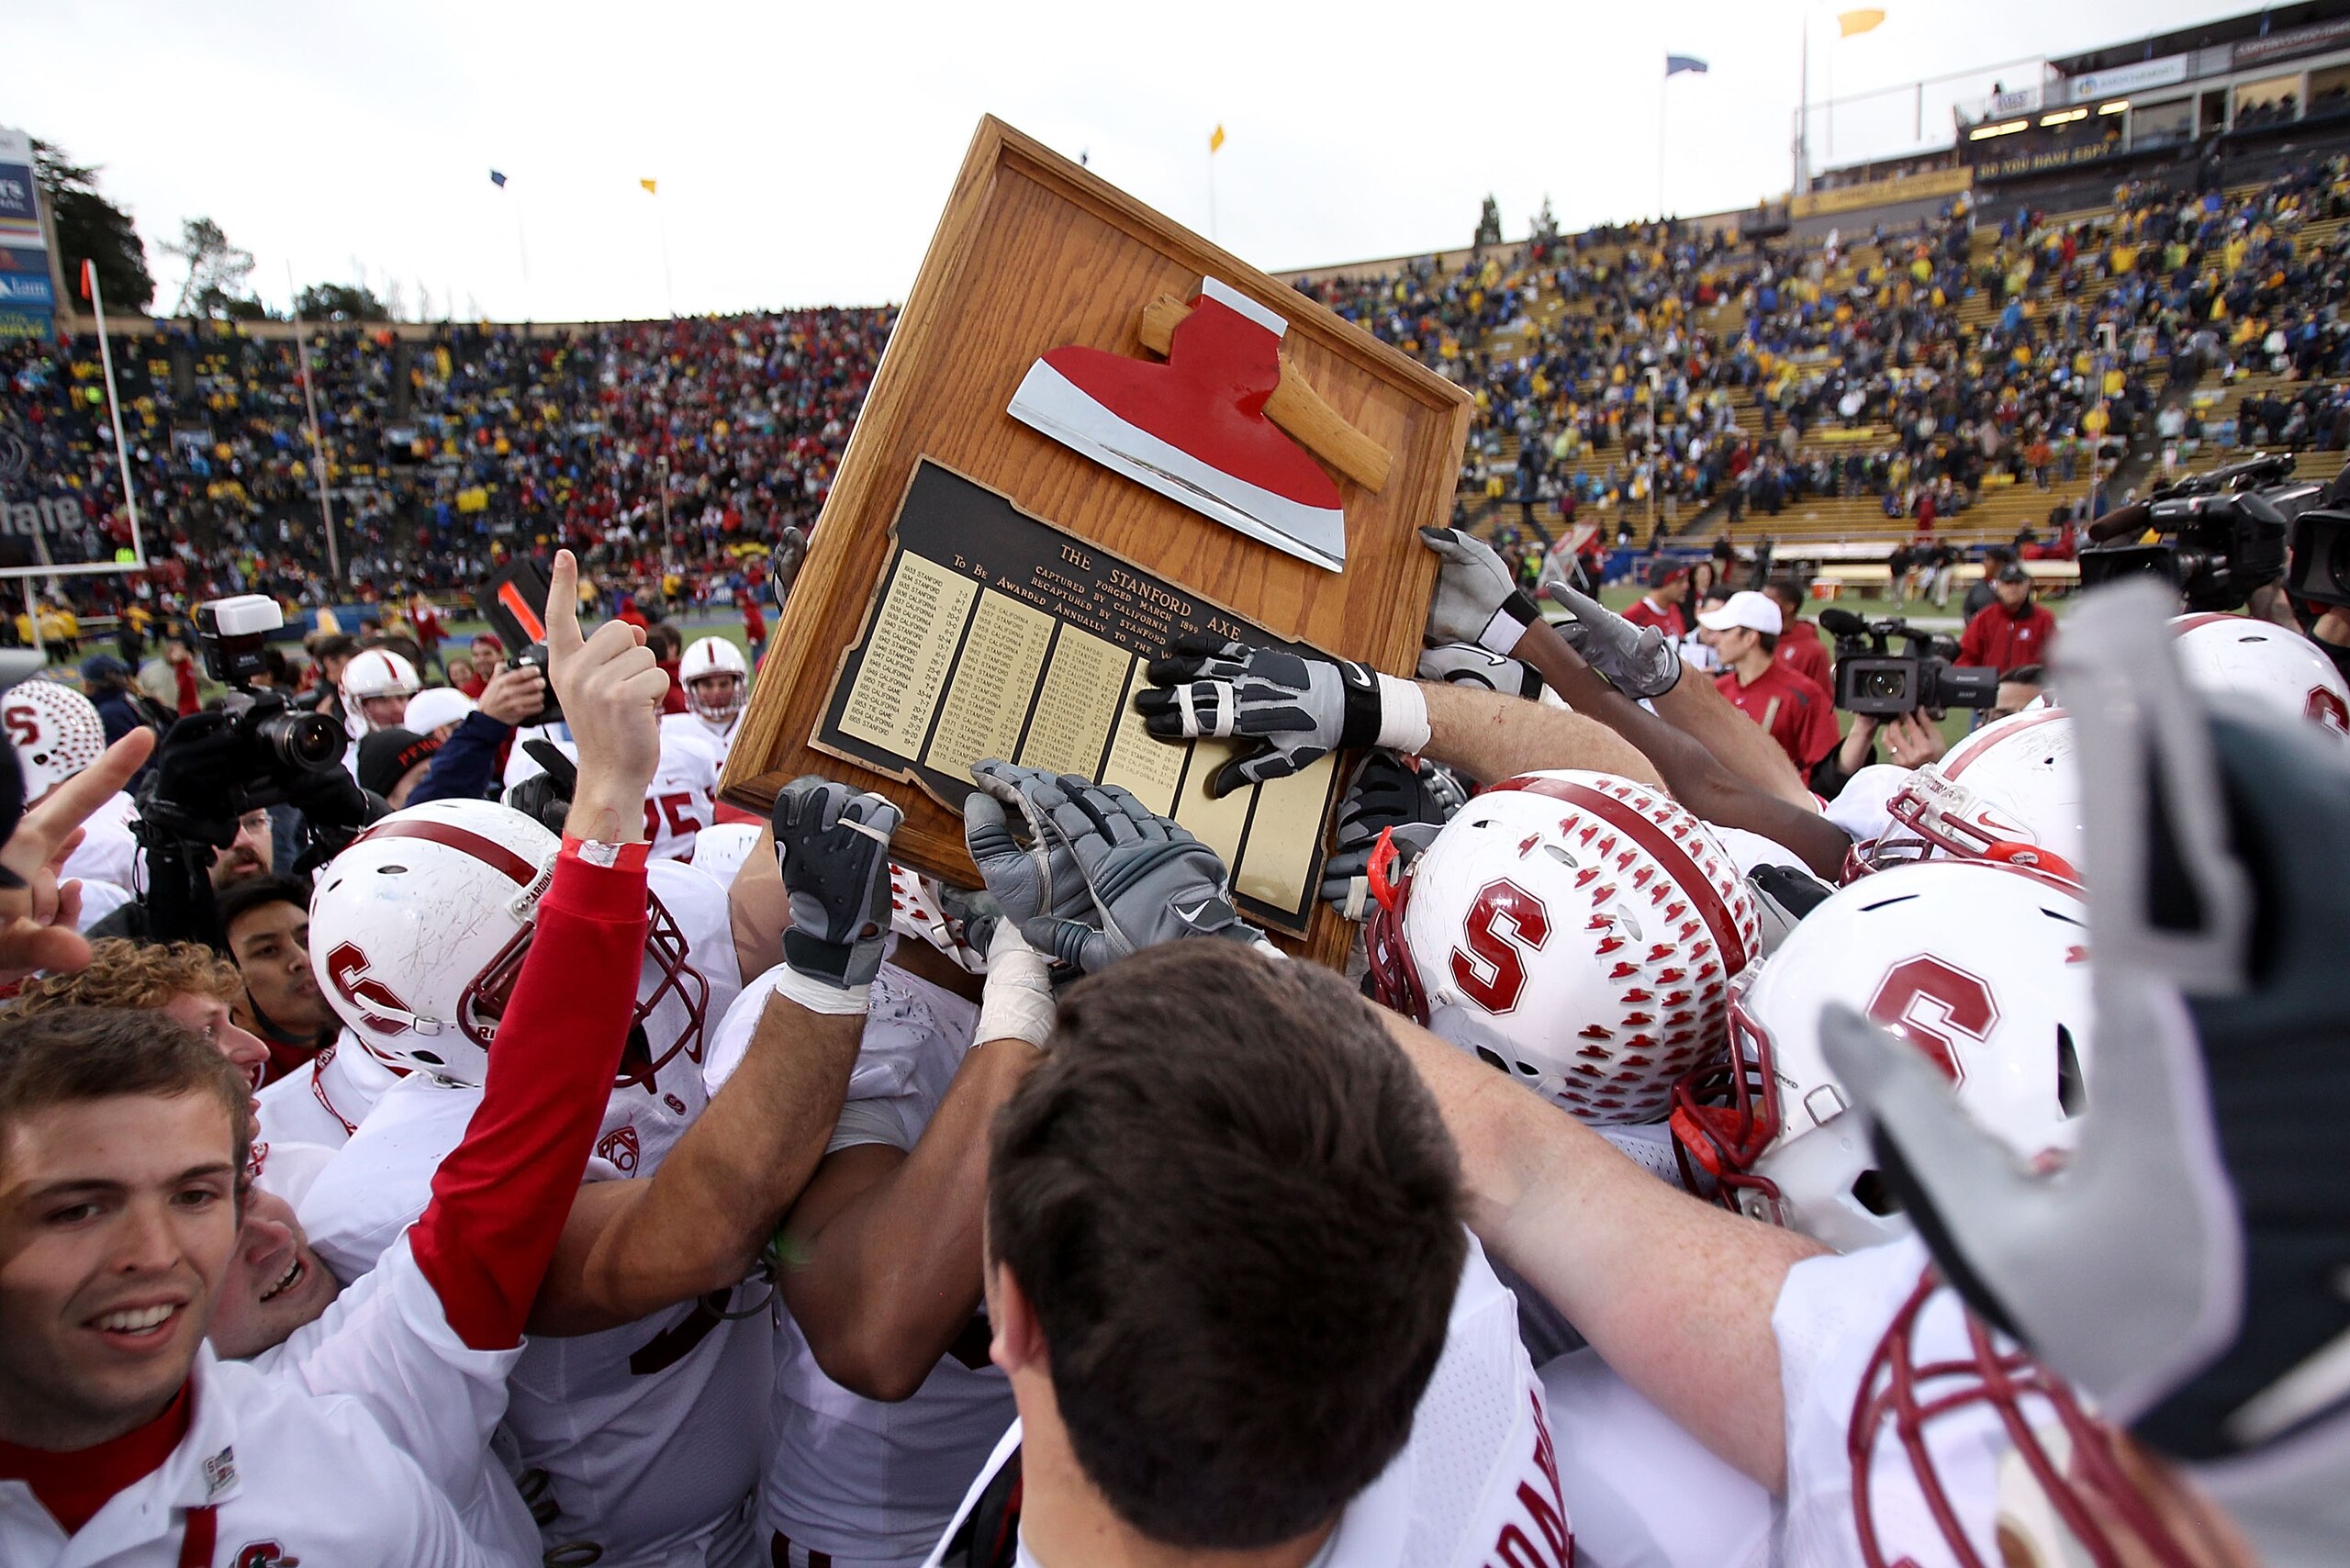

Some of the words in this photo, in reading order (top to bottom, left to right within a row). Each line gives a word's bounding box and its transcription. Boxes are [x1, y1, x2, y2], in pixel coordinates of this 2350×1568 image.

[2003, 157, 2030, 174] YOU
[2034, 151, 2069, 169] HAVE
[0, 495, 86, 536] tate
[912, 577, 941, 595] STANFORD
[915, 570, 944, 588] STANFORD
[907, 593, 937, 611] CALIFORNIA
[910, 586, 938, 603] STANFORD
[1035, 565, 1085, 594] CAPTURED
[1092, 592, 1106, 604] BY
[1113, 602, 1169, 634] CALIFORNIA
[1060, 543, 1093, 571] THE
[1109, 568, 1192, 618] STANFORD
[1206, 616, 1241, 643] AXE
[904, 600, 934, 619] CALIFORNIA
[996, 576, 1047, 607] AWARDED
[1053, 601, 1107, 633] ANNUALLY
[1113, 631, 1127, 643] TO
[1134, 641, 1152, 655] THE
[998, 607, 1030, 625] CALIFORNIA
[1030, 577, 1092, 611] RECAPTURED
[1099, 609, 1112, 621] BY
[1119, 619, 1167, 646] STANFORD
[1094, 579, 1133, 603] FORGED
[1139, 600, 1173, 622] MARCH
[1180, 620, 1200, 635] 1899
[899, 617, 929, 635] CALIFORNIA
[901, 609, 932, 627] CALIFORNIA
[995, 614, 1024, 631] STANFORD
[896, 624, 924, 642] STANFORD
[990, 629, 1023, 648] CALIFORNIA
[992, 622, 1024, 641] CALIFORNIA
[890, 632, 922, 650] CALIFORNIA
[890, 640, 919, 657] STANFORD
[988, 637, 1020, 655] CALIFORNIA
[1075, 641, 1104, 658] STANFORD
[887, 648, 915, 666] STANFORD
[982, 653, 1012, 669] STANFORD
[985, 644, 1013, 662] STANFORD
[1073, 648, 1102, 666] STANFORD
[881, 664, 912, 682] CALIFORNIA
[884, 655, 915, 673] CALIFORNIA
[979, 660, 1009, 678] STANFORD
[1069, 662, 1101, 681] CALIFORNIA
[1071, 655, 1100, 673] STANFORD
[876, 680, 886, 689] TIE
[878, 672, 910, 690] CALIFORNIA
[975, 676, 1003, 693] STANFORD
[977, 668, 1006, 685] STANFORD
[1064, 677, 1093, 694] STANFORD
[1067, 669, 1099, 689] CALIFORNIA
[870, 688, 902, 705] CALIFORNIA
[969, 691, 1002, 711] CALIFORNIA
[972, 684, 1002, 700] STANFORD
[1059, 690, 1092, 710] CALIFORNIA
[1062, 683, 1094, 702] CALIFORNIA
[867, 704, 878, 713] TIE
[964, 707, 993, 724] STANFORD
[967, 700, 996, 717] STANFORD
[1055, 705, 1085, 722] STANFORD
[1058, 698, 1087, 715] STANFORD
[861, 720, 890, 736] STANFORD
[864, 711, 896, 730] CALIFORNIA
[961, 715, 995, 734] CALIFORNIA
[1050, 720, 1080, 737] STANFORD
[1053, 712, 1086, 731] CALIFORNIA
[956, 731, 986, 748] CALIFORNIA
[958, 723, 989, 741] STANFORD
[1048, 726, 1058, 735] TIE
[953, 739, 983, 756] STANFORD
[1044, 742, 1073, 759] STANFORD
[1046, 734, 1076, 752] STANFORD
[1039, 756, 1069, 774] STANFORD
[1041, 749, 1071, 767] STANFORD
[1448, 875, 1554, 1017] S
[326, 940, 414, 1037] S
